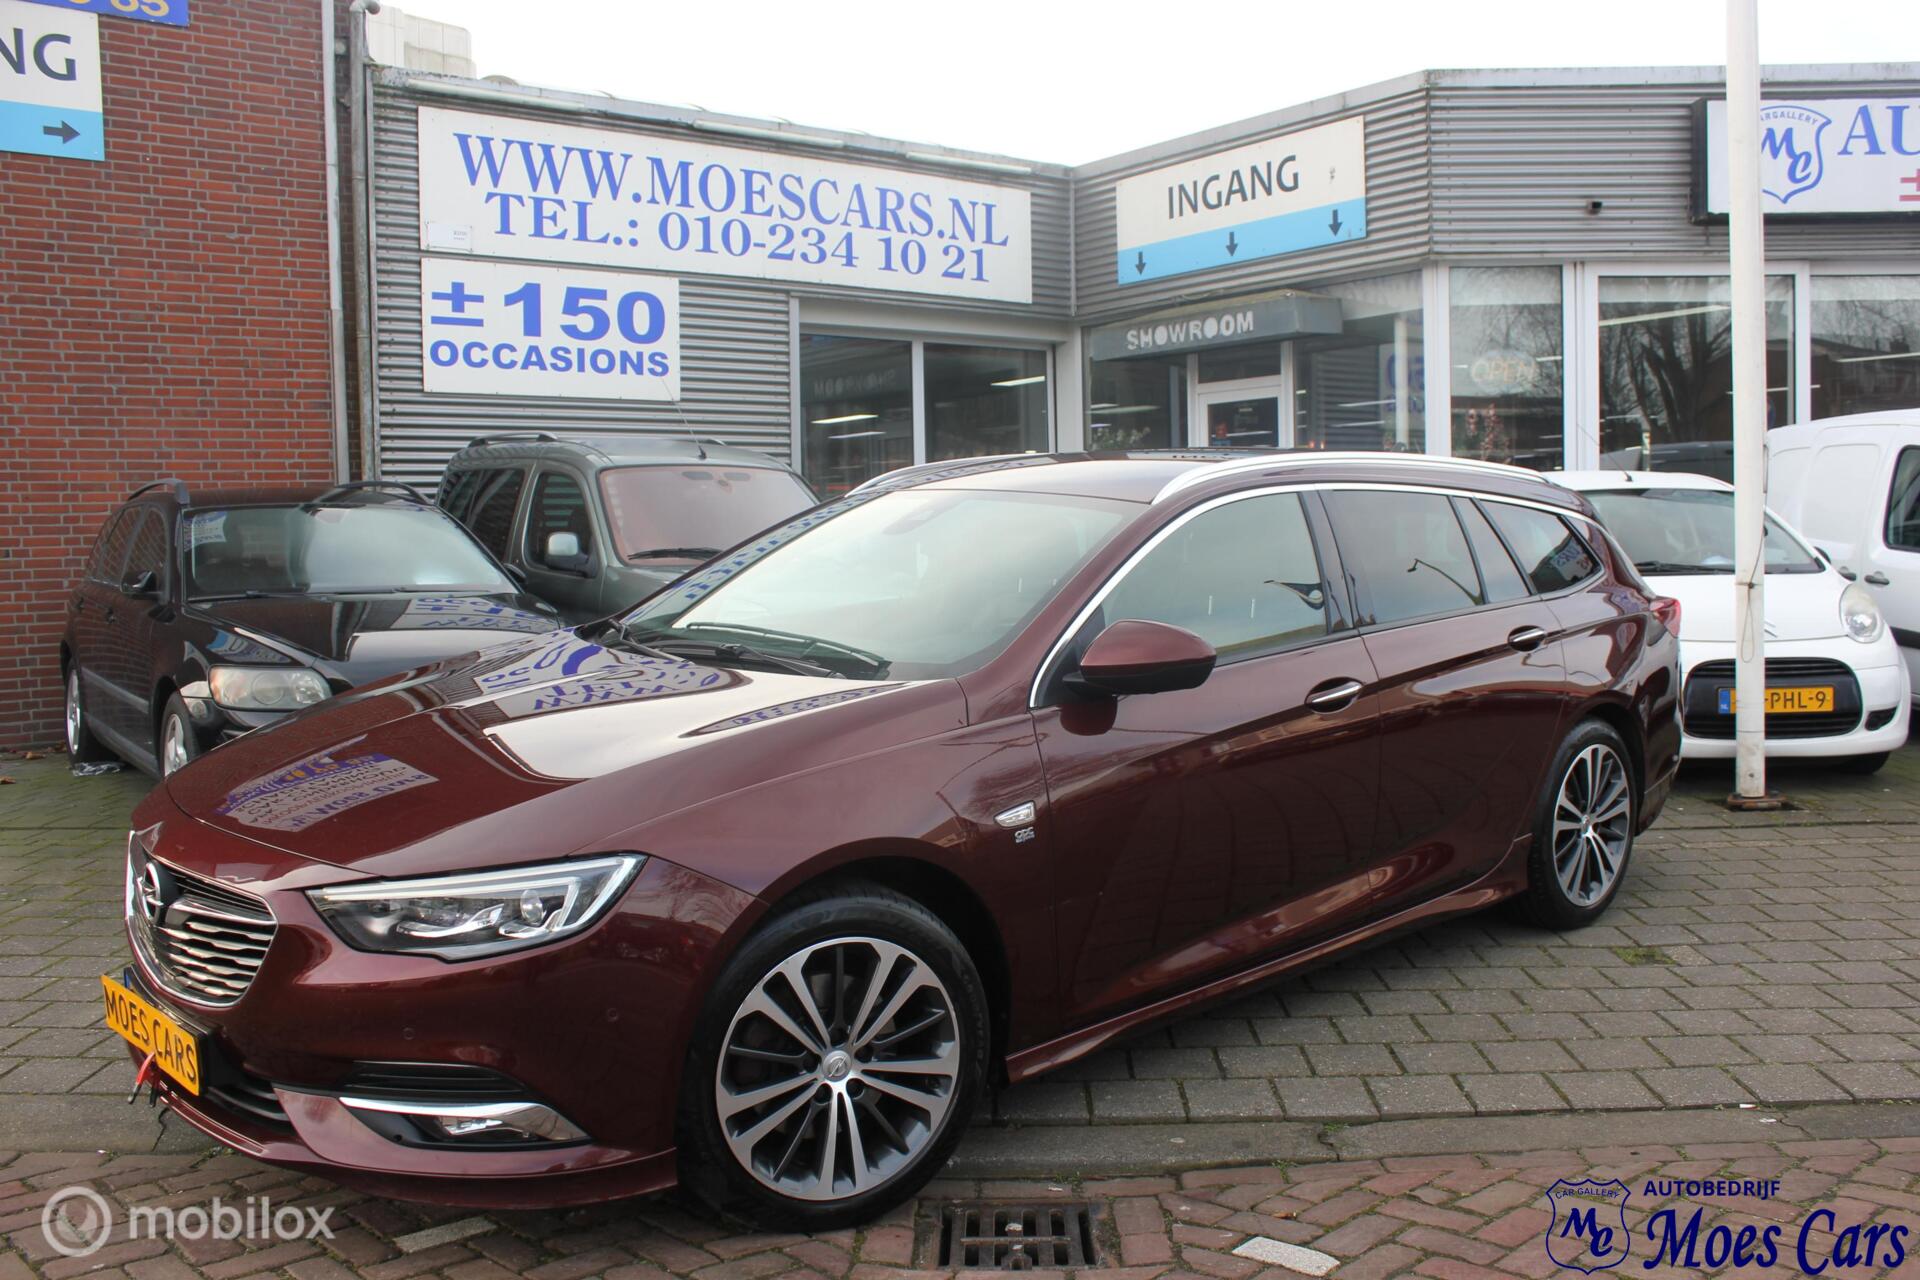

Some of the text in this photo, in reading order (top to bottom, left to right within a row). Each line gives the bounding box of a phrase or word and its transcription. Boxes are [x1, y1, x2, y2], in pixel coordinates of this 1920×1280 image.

[452, 132, 1010, 248] WWW.MOESCARS.NL
[1168, 155, 1299, 220] INGANG
[484, 190, 990, 284] TEL.: 010-234 10 21
[428, 338, 671, 379] OCCASIONS
[1126, 310, 1255, 351] SHOWROOM
[102, 984, 197, 1083] MOES CARS
